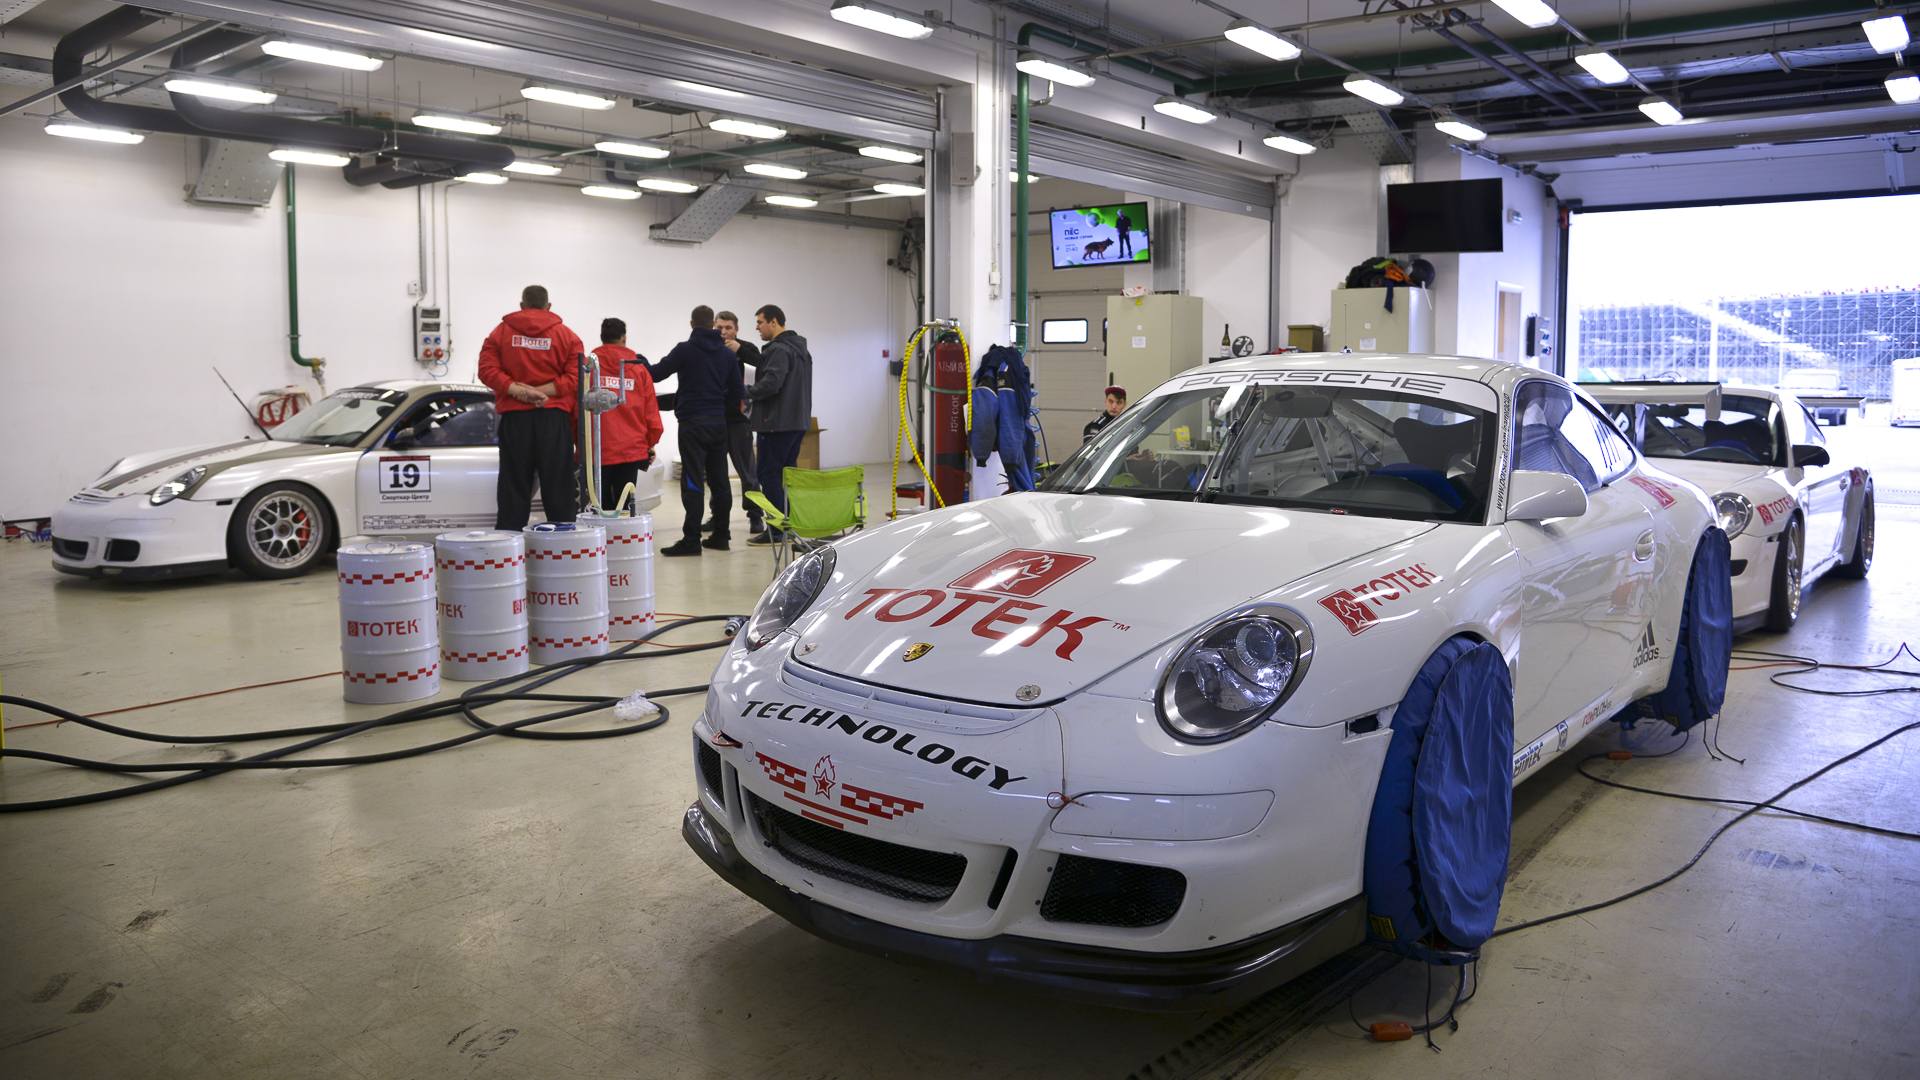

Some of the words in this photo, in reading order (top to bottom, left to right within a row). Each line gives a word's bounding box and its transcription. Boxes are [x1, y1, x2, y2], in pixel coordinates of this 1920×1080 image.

[1180, 372, 1446, 394] PORSCHE
[389, 464, 420, 488] 19
[1351, 563, 1437, 606] TOTEK
[440, 603, 464, 619] TEK
[360, 619, 418, 637] TOTEK
[843, 588, 1114, 662] TOTEK
[1633, 647, 1660, 669] adidas
[740, 700, 1028, 791] TECHNOLOGY
